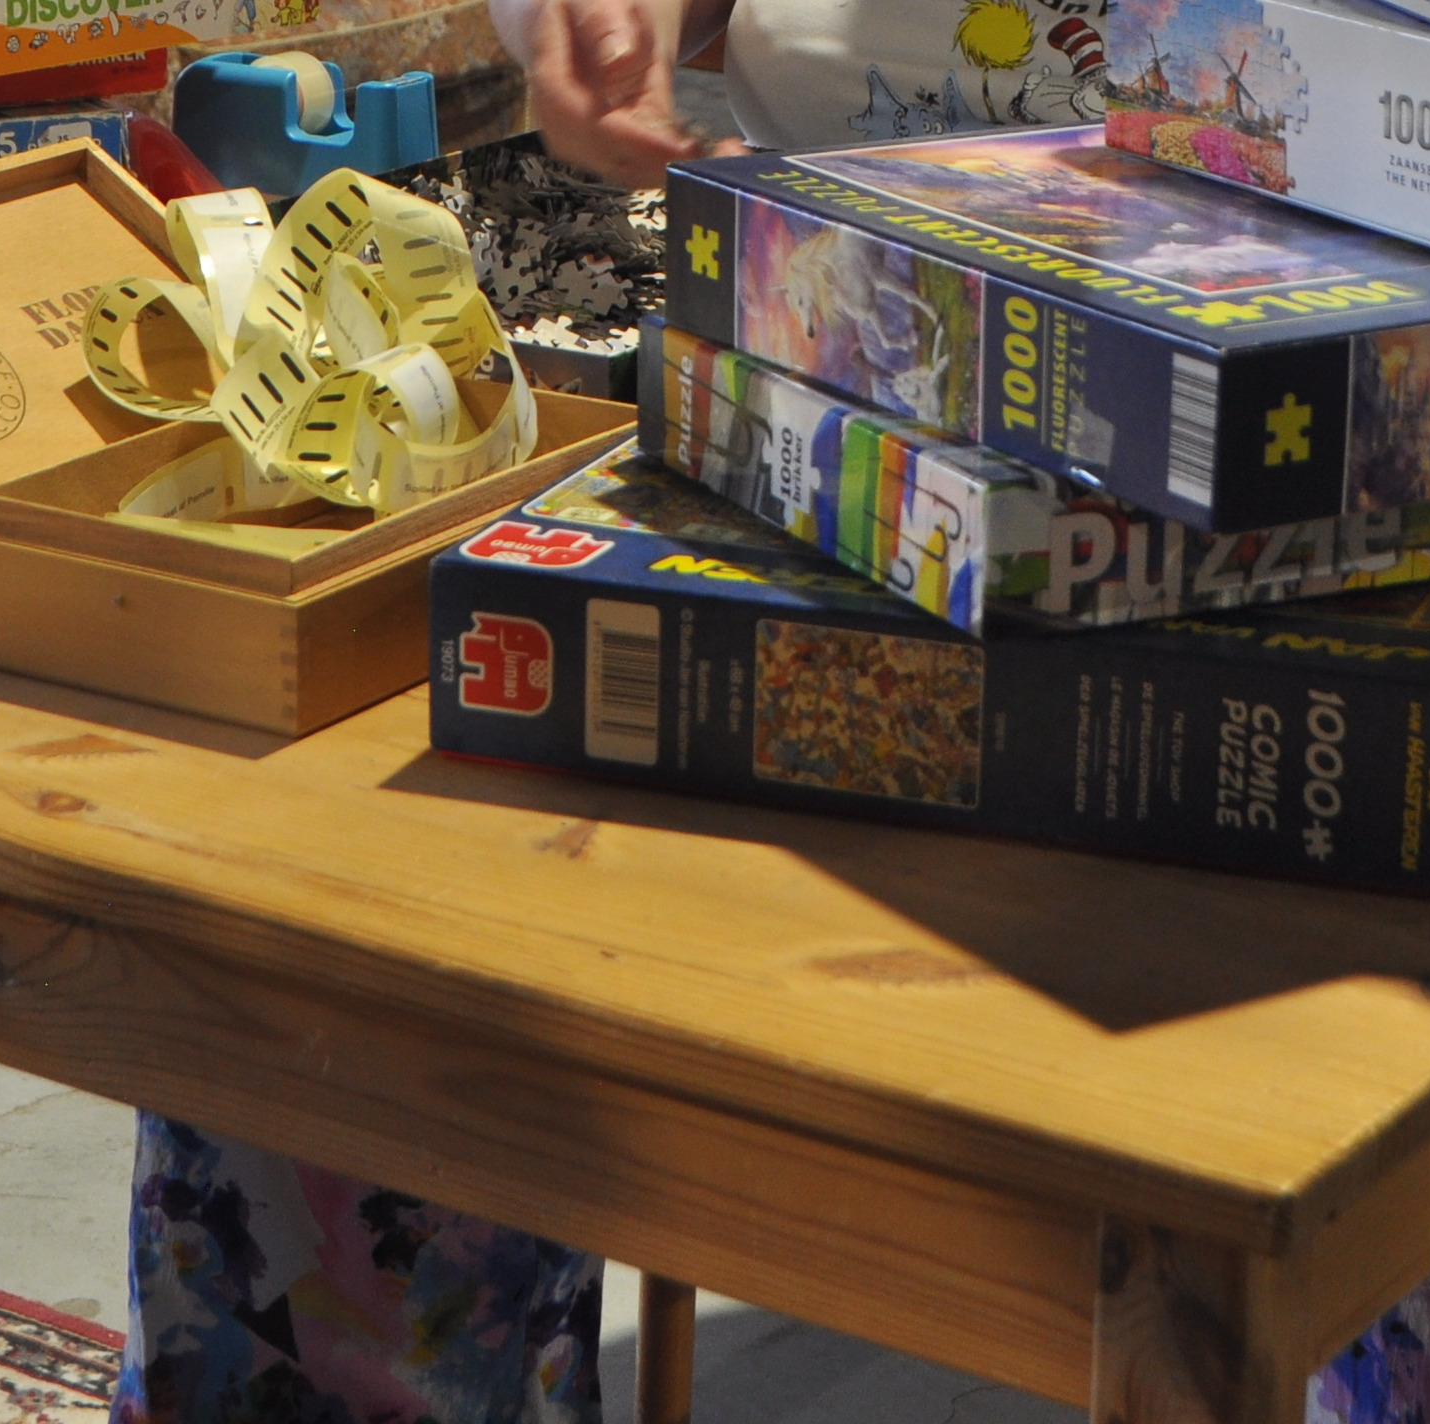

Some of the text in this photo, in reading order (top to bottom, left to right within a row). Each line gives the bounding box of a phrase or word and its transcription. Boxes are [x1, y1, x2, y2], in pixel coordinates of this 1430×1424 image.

[759, 172, 1185, 306] FLUORESCENT PUZZLE
[1385, 169, 1407, 188] THE
[1001, 295, 1040, 432] 1000
[1051, 308, 1071, 453] FLUORESCENT
[778, 426, 793, 500] 1000
[792, 432, 804, 504] brikker
[441, 637, 455, 684] 19073
[1214, 695, 1249, 829] PUZZLE
[1247, 703, 1283, 832] COMIC
[1302, 687, 1347, 819] 1000
[1399, 734, 1427, 873] HAASTEREN
